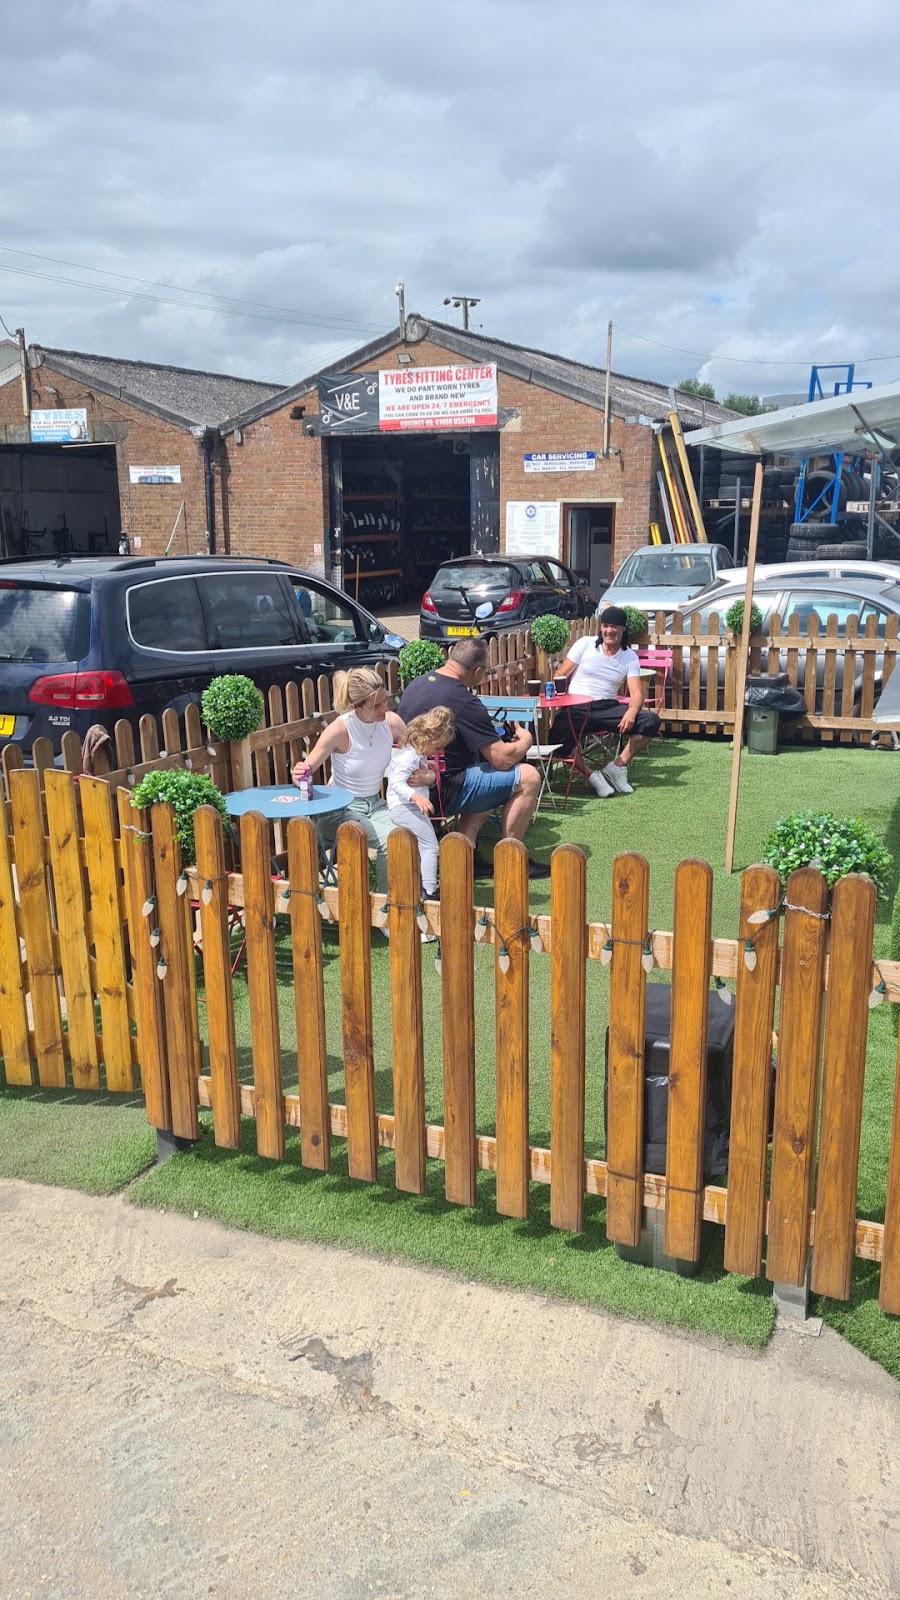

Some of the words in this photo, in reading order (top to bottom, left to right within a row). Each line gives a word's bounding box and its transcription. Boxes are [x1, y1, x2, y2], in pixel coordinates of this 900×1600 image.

[384, 372, 413, 385] TYRES
[416, 370, 453, 383] FITTING
[455, 367, 492, 381] CENTER
[335, 392, 360, 410] V&E
[32, 411, 84, 420] TYRES
